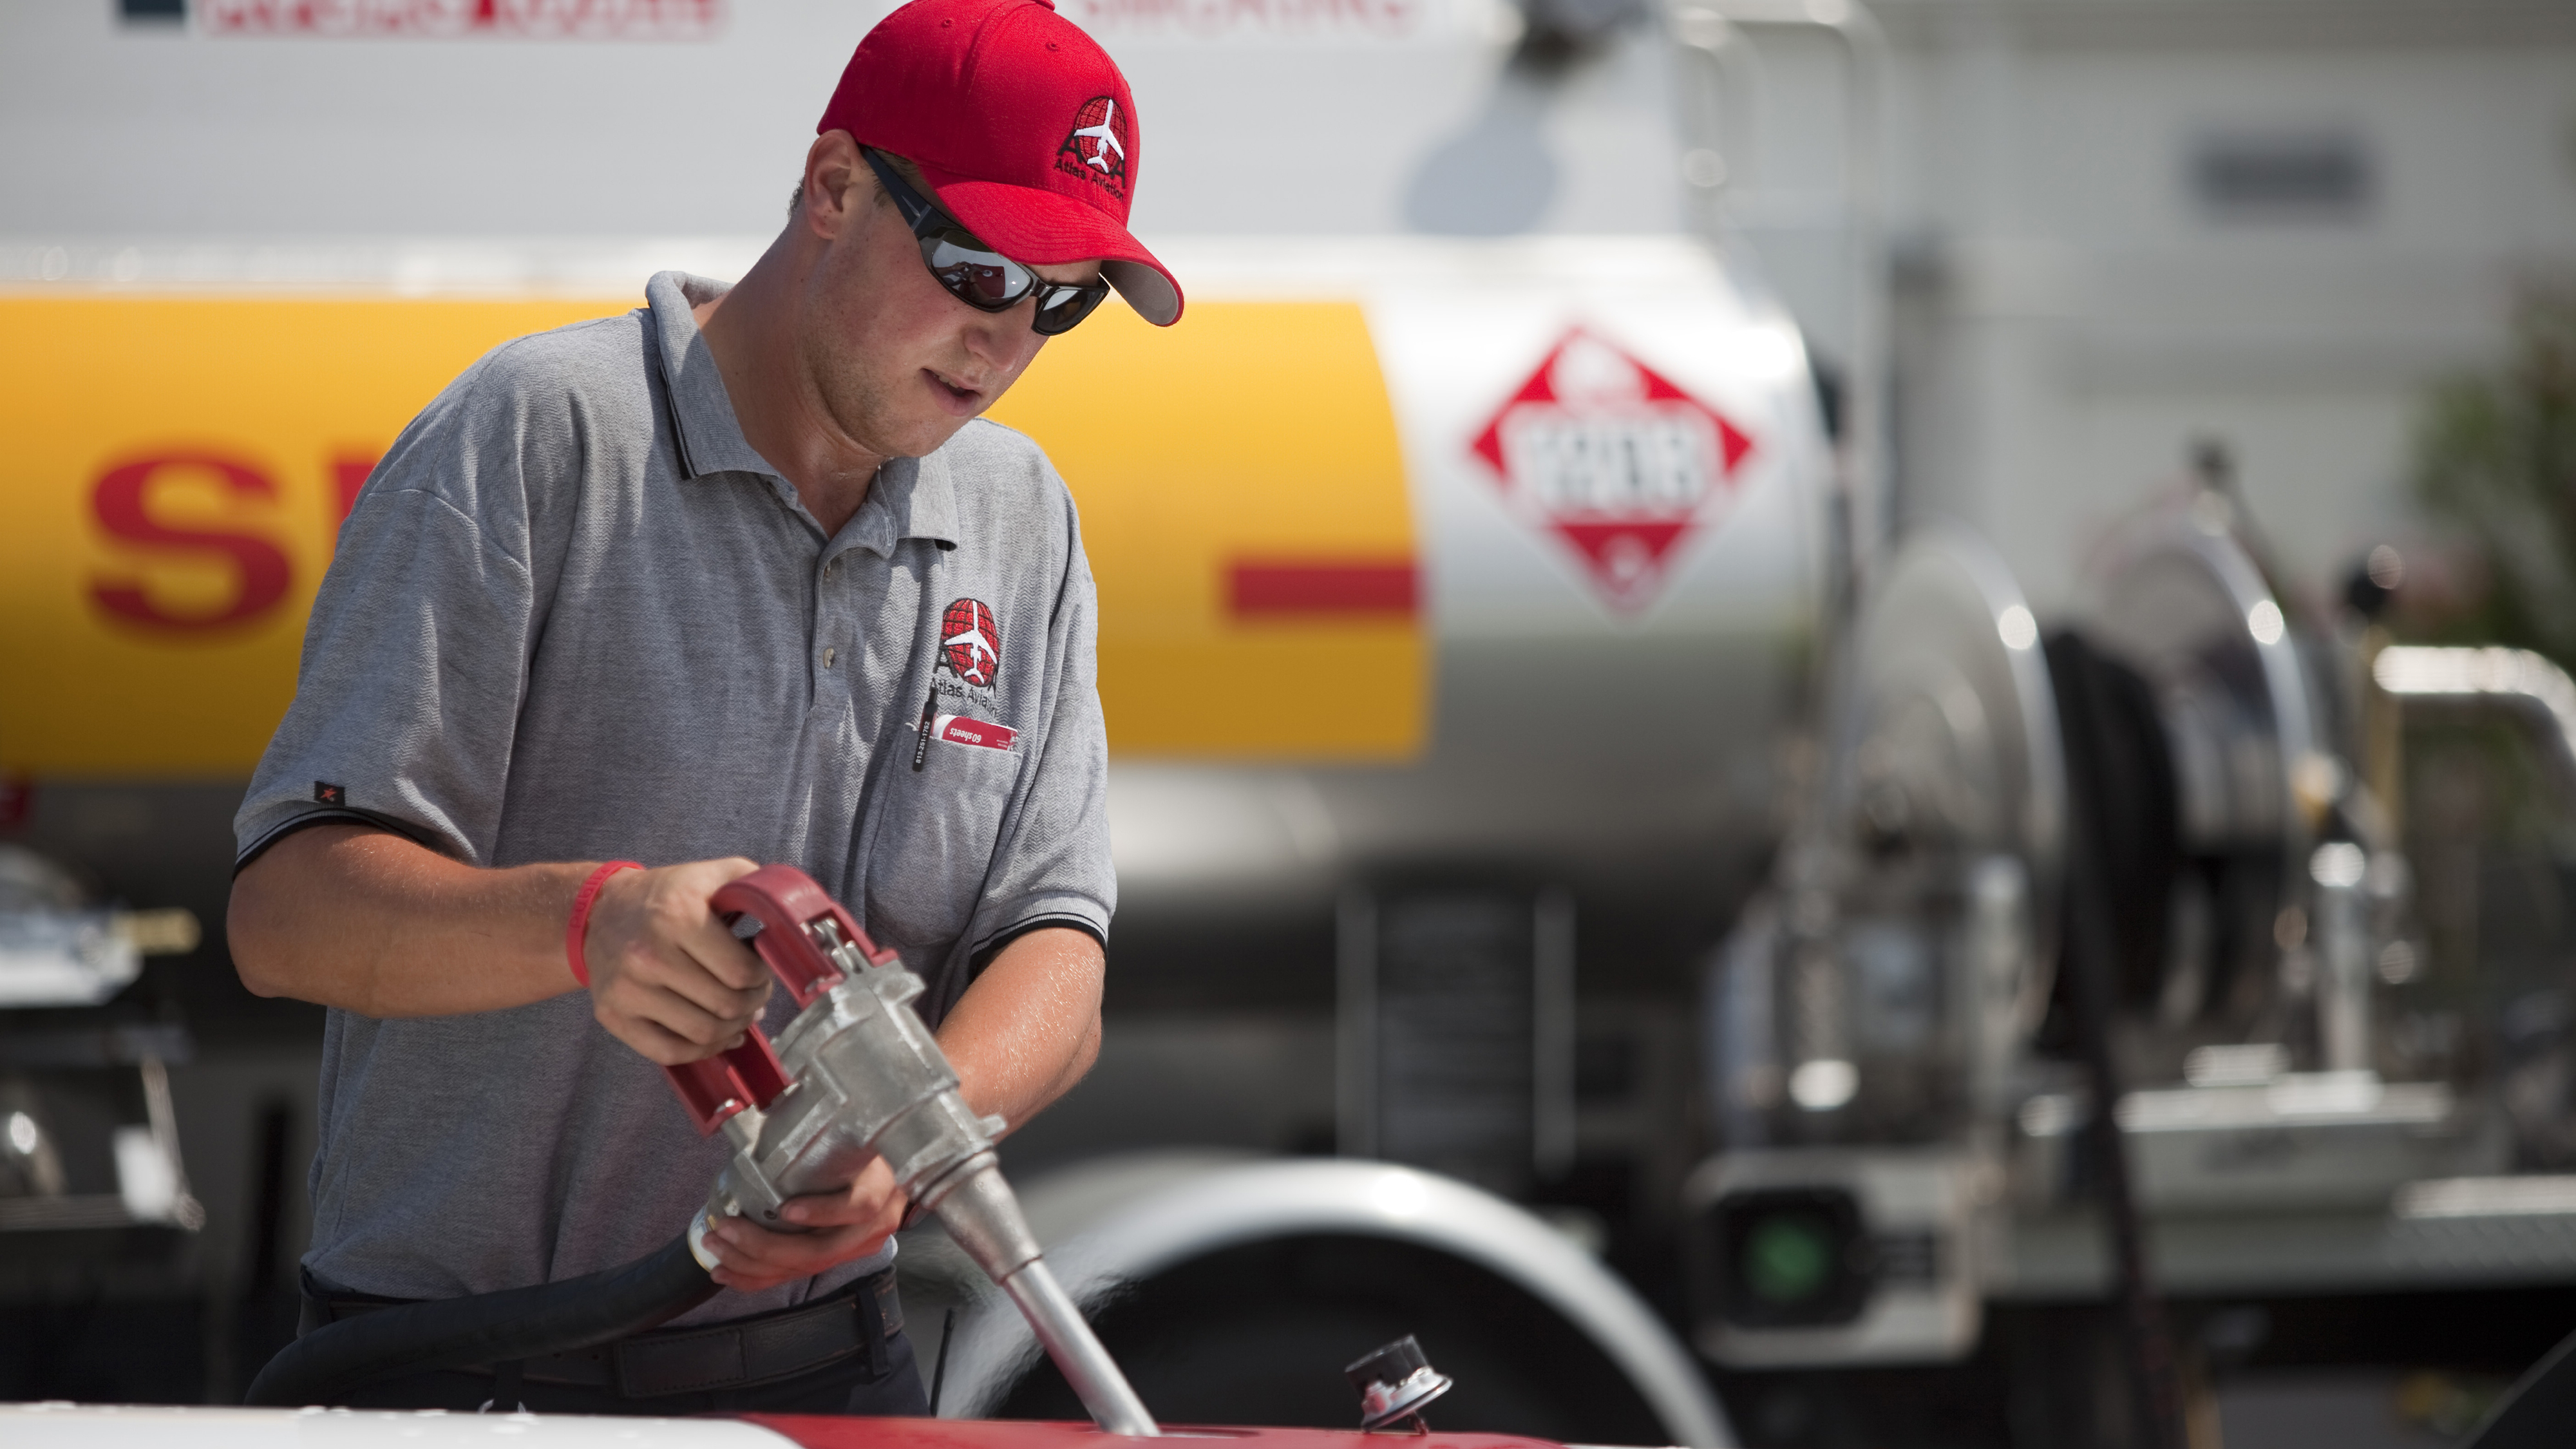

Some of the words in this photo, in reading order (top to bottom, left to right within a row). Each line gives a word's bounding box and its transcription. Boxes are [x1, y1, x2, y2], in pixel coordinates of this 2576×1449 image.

[1054, 158, 1086, 180] Atlas
[1091, 172, 1124, 204] Aviation
[937, 679, 963, 697] tlas
[916, 721, 930, 764] 813-251-1752
[949, 727, 972, 741] sheets
